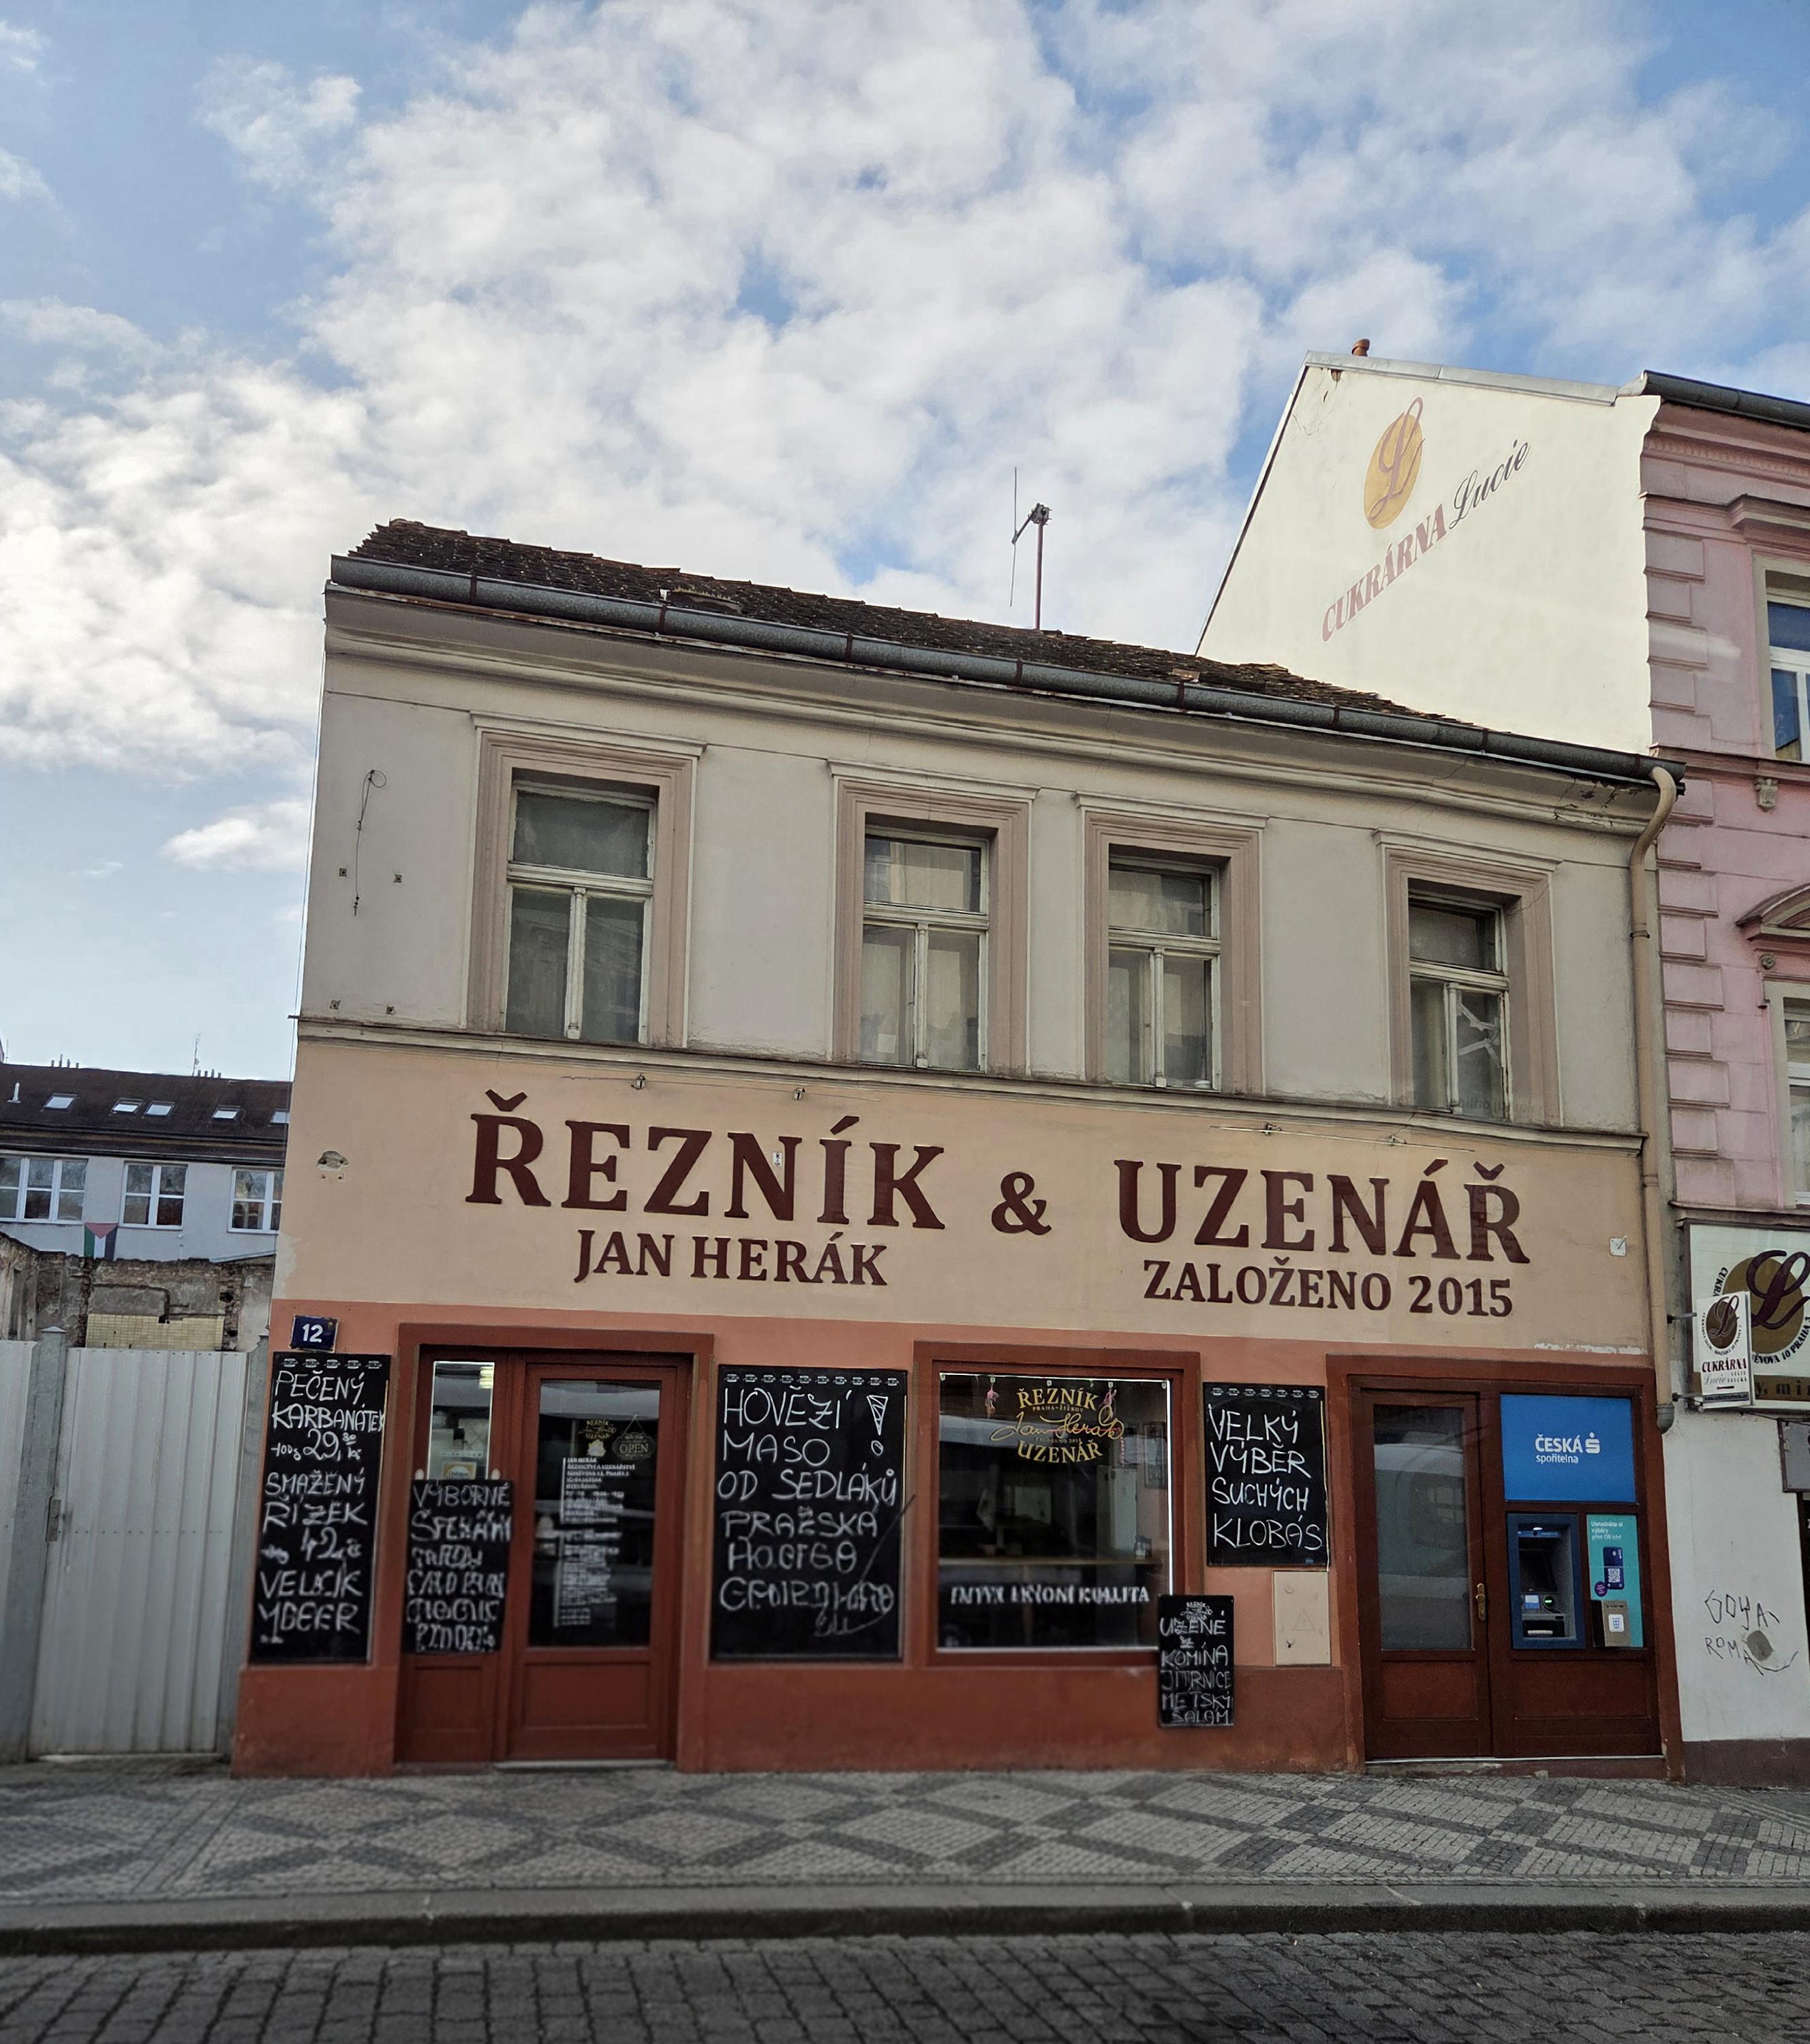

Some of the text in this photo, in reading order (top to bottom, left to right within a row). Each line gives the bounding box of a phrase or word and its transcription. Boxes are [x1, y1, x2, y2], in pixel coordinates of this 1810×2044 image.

[1321, 439, 1530, 642] CUKRÁRNA Lucie
[465, 1090, 1531, 1264] ŘEZNÍK & UZENÁŘ
[574, 1229, 889, 1286] JAN HERÁK
[1143, 1256, 1514, 1317] ZALOŽENO 2015
[302, 1323, 324, 1343] 12
[1752, 1352, 1780, 1364] ĚVOVA
[1781, 1350, 1791, 1361] 10
[1790, 1325, 1810, 1354] PRAHA
[1702, 1357, 1747, 1373] CUKRÁRNA
[275, 1369, 365, 1405] PEČENÝ
[1017, 1388, 1099, 1411] ŘEZNÍK
[272, 1401, 385, 1432] KARBANÁTEK
[724, 1385, 852, 1429] HOVĚZÍ
[1208, 1404, 1298, 1444] VELKÝ
[619, 1443, 649, 1454] OPEN
[723, 1429, 830, 1466] MASO
[1017, 1438, 1103, 1464] UZENÁŘ
[1210, 1441, 1312, 1478] VÝBĚR
[1535, 1434, 1583, 1453] ČESKÁ
[1535, 1453, 1579, 1464] spořitelna
[264, 1466, 365, 1496] SMAŽENÝ
[414, 1479, 510, 1507] VÝBORNÉ
[718, 1462, 896, 1506] OD SEDLÁKŮ
[1212, 1476, 1308, 1511] SUCHÝCH
[1214, 1513, 1322, 1551] KLOBÁS
[1160, 1609, 1226, 1636] UZENÉ
